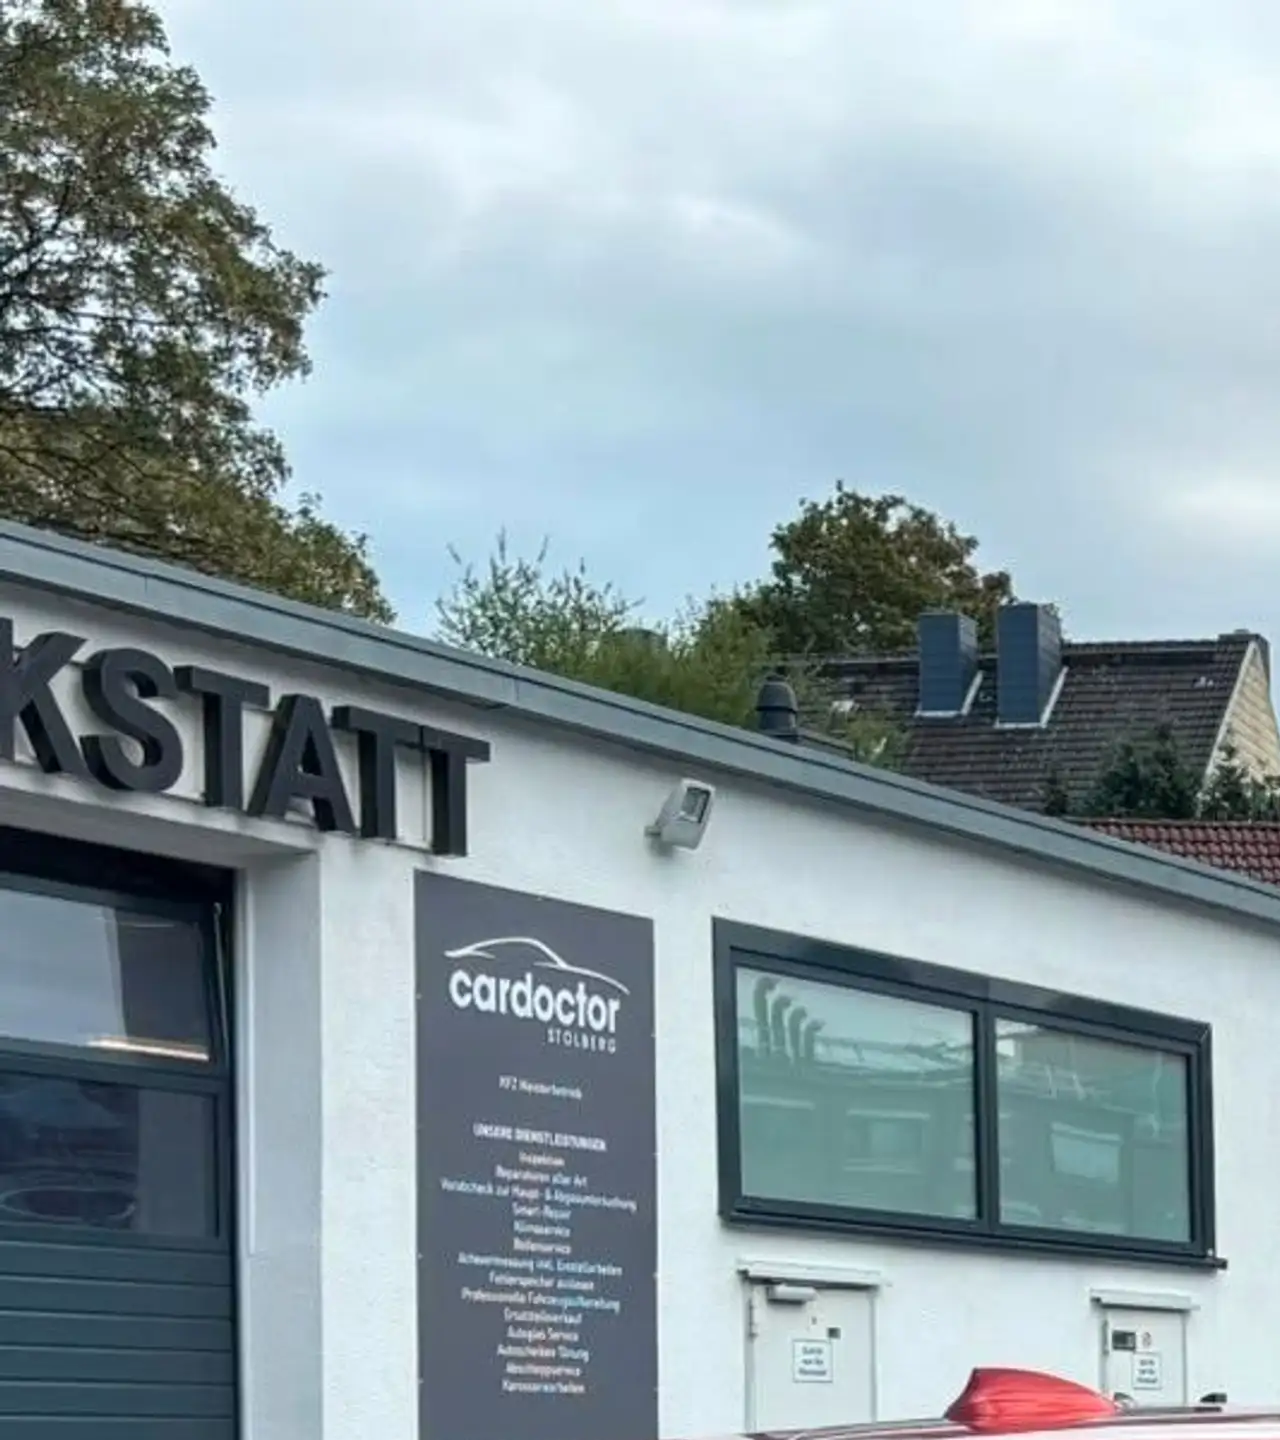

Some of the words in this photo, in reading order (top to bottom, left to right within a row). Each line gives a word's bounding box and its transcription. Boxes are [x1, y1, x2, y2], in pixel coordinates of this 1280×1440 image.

[0, 616, 490, 857] KSTATT
[449, 969, 621, 1033] cardoctor
[546, 1028, 618, 1053] STOLBERG
